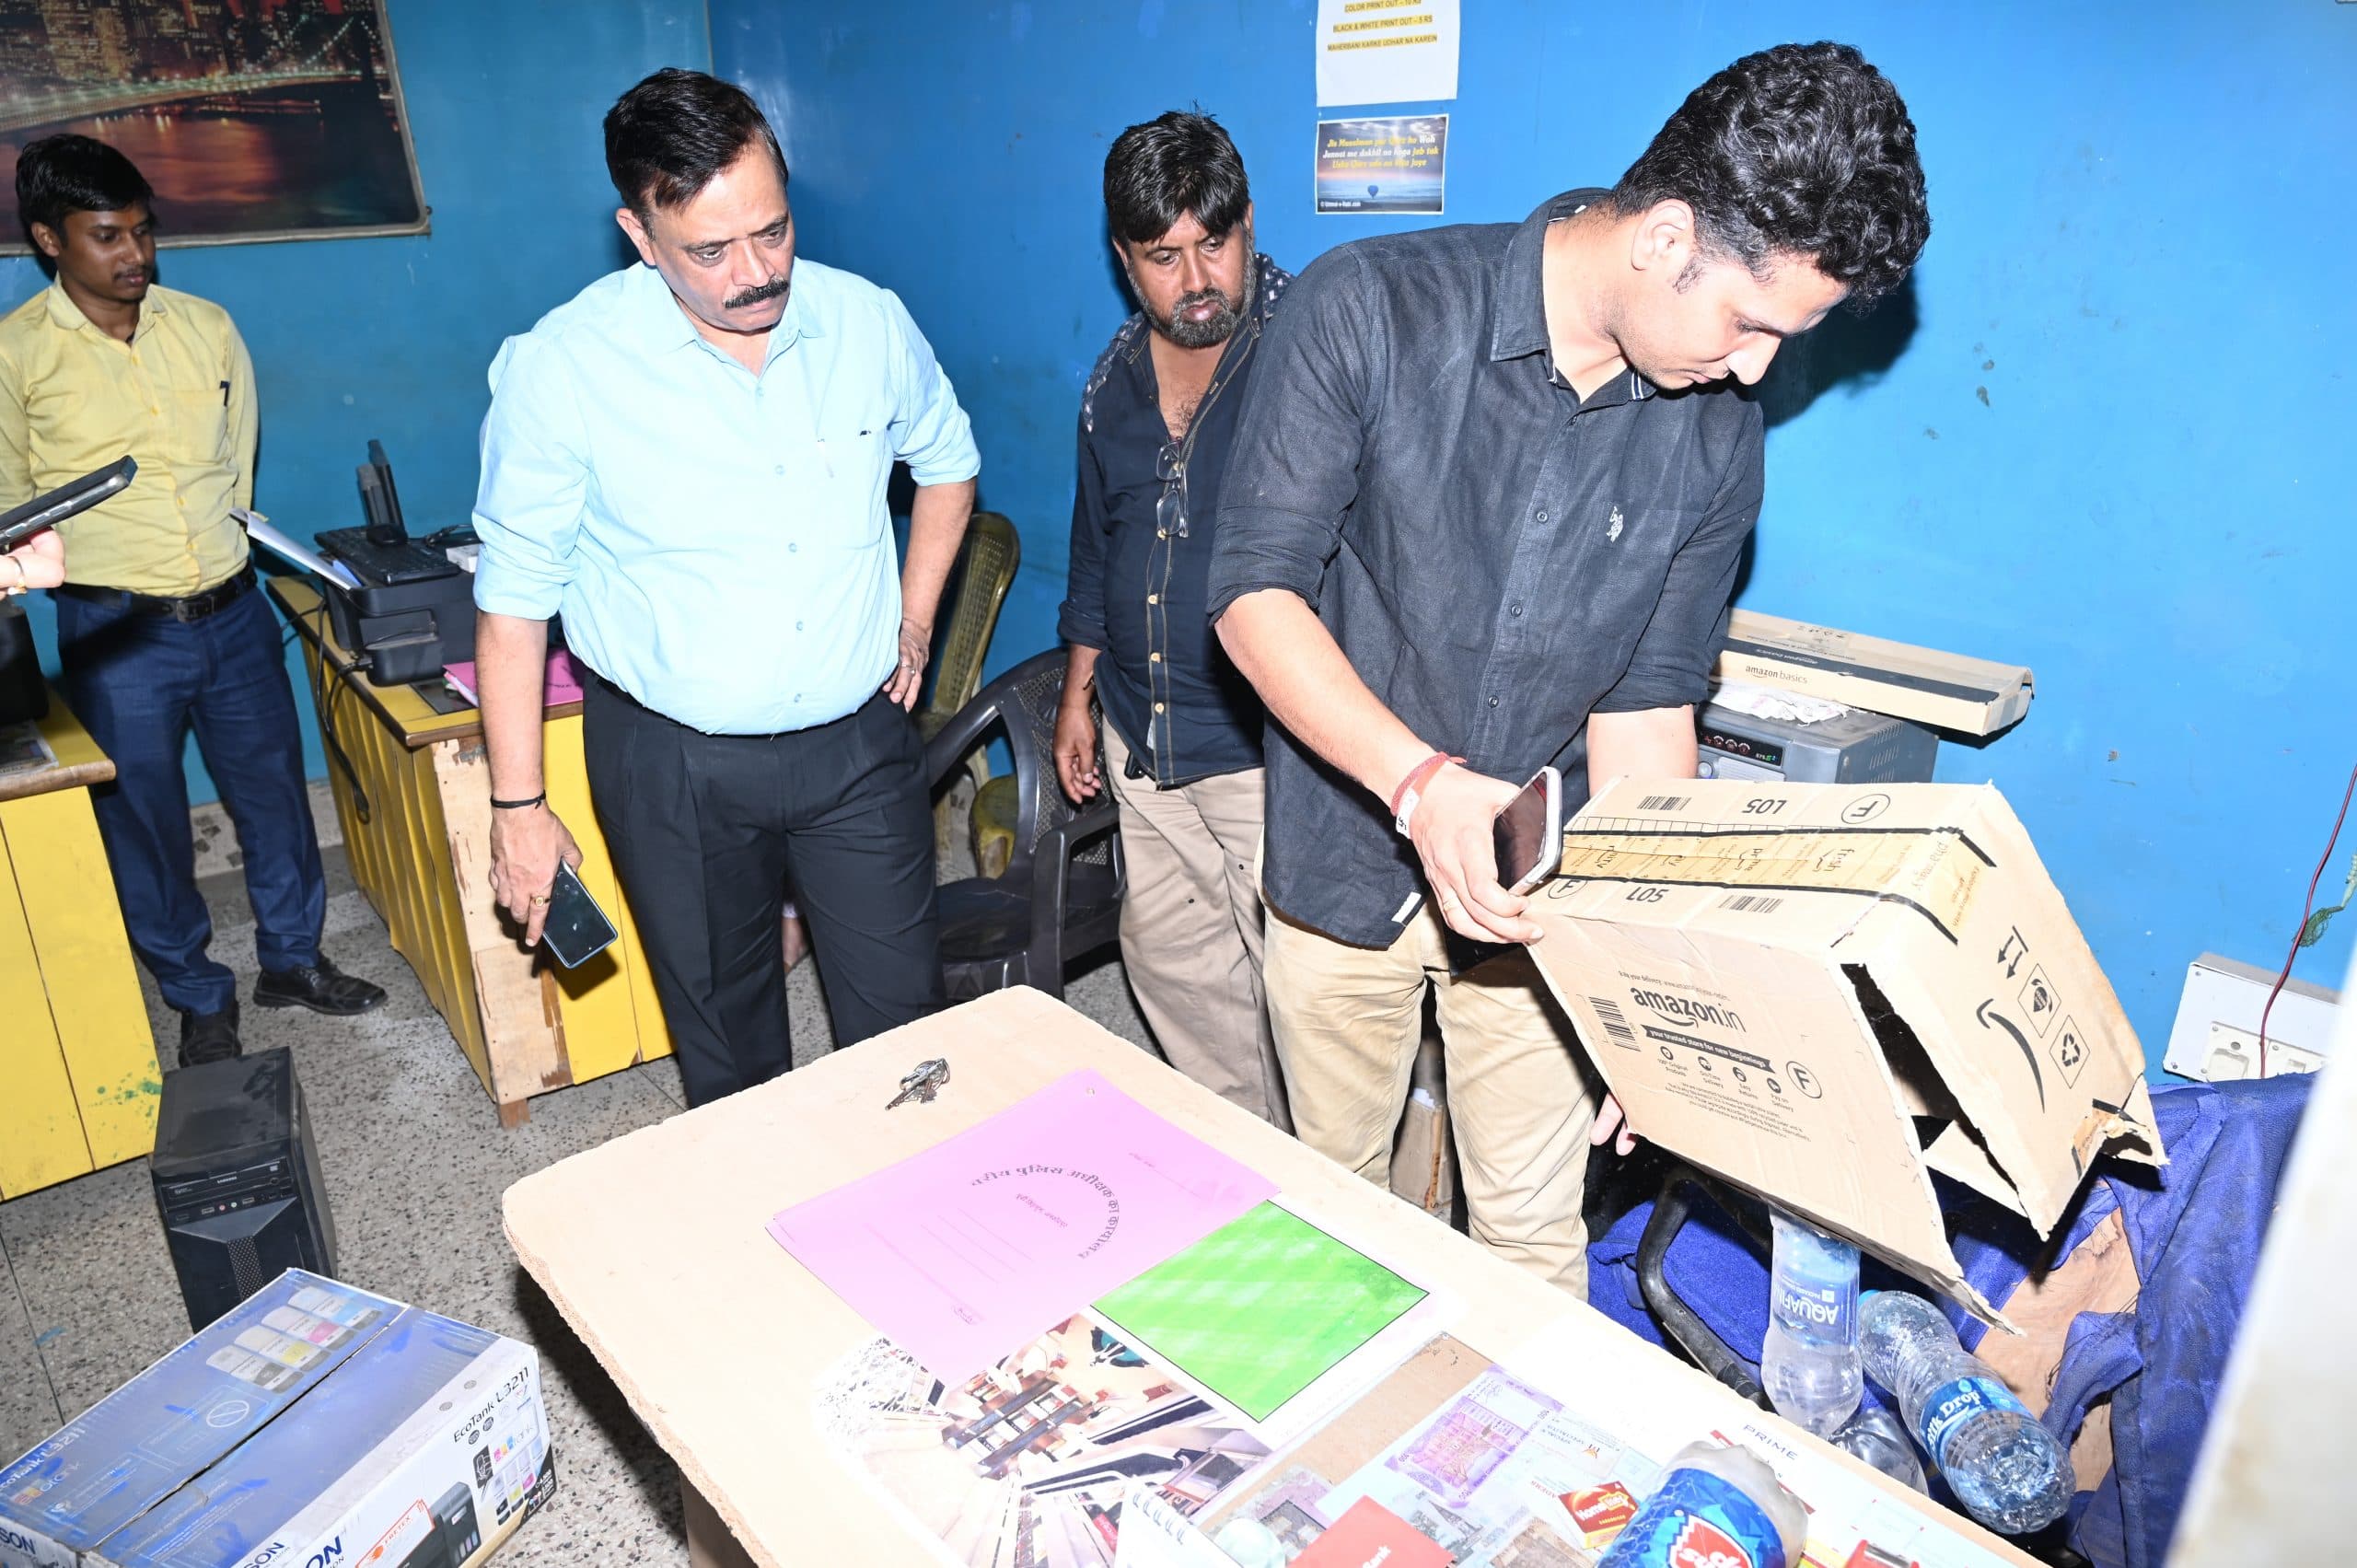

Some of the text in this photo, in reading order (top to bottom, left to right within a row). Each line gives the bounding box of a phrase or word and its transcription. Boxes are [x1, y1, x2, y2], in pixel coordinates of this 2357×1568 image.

[1344, 4, 1366, 13] COLOR
[1366, 2, 1384, 10] PRINT
[1333, 25, 1353, 33] BLACK
[1360, 21, 1379, 30] WHITE
[1381, 19, 1399, 28] PRINT
[1399, 17, 1412, 26] OUT
[1630, 986, 1747, 1033] amazon.in
[1664, 1032, 1688, 1045] trusted
[1688, 1038, 1704, 1049] store
[1015, 1164, 1063, 1177] पुलिस
[453, 1401, 494, 1444] EcoTank
[495, 1366, 529, 1403] L3211
[1938, 1389, 1981, 1418] Drop
[1743, 1424, 1798, 1460] PRIME
